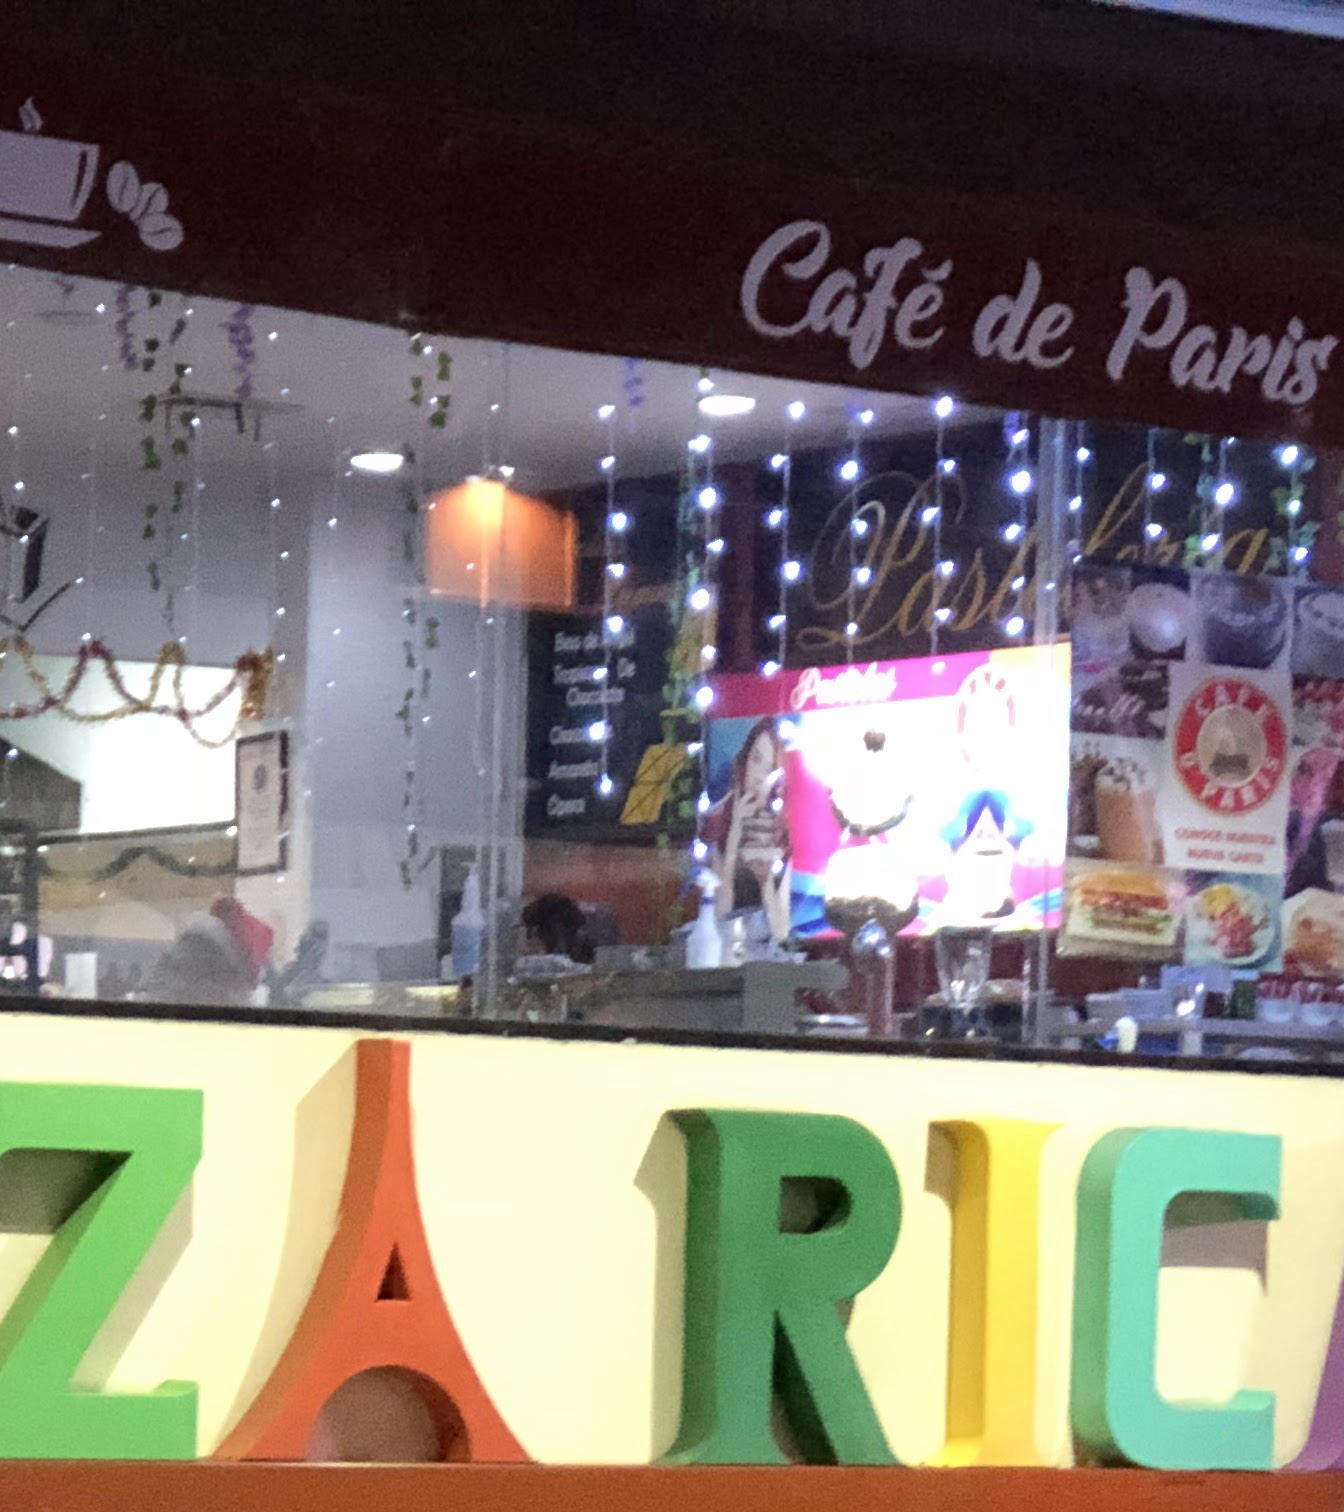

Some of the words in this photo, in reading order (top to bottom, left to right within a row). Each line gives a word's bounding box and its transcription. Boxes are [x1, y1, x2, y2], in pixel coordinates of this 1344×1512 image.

[741, 219, 953, 370] Café
[971, 258, 1075, 370] de
[1106, 265, 1338, 404] Paris
